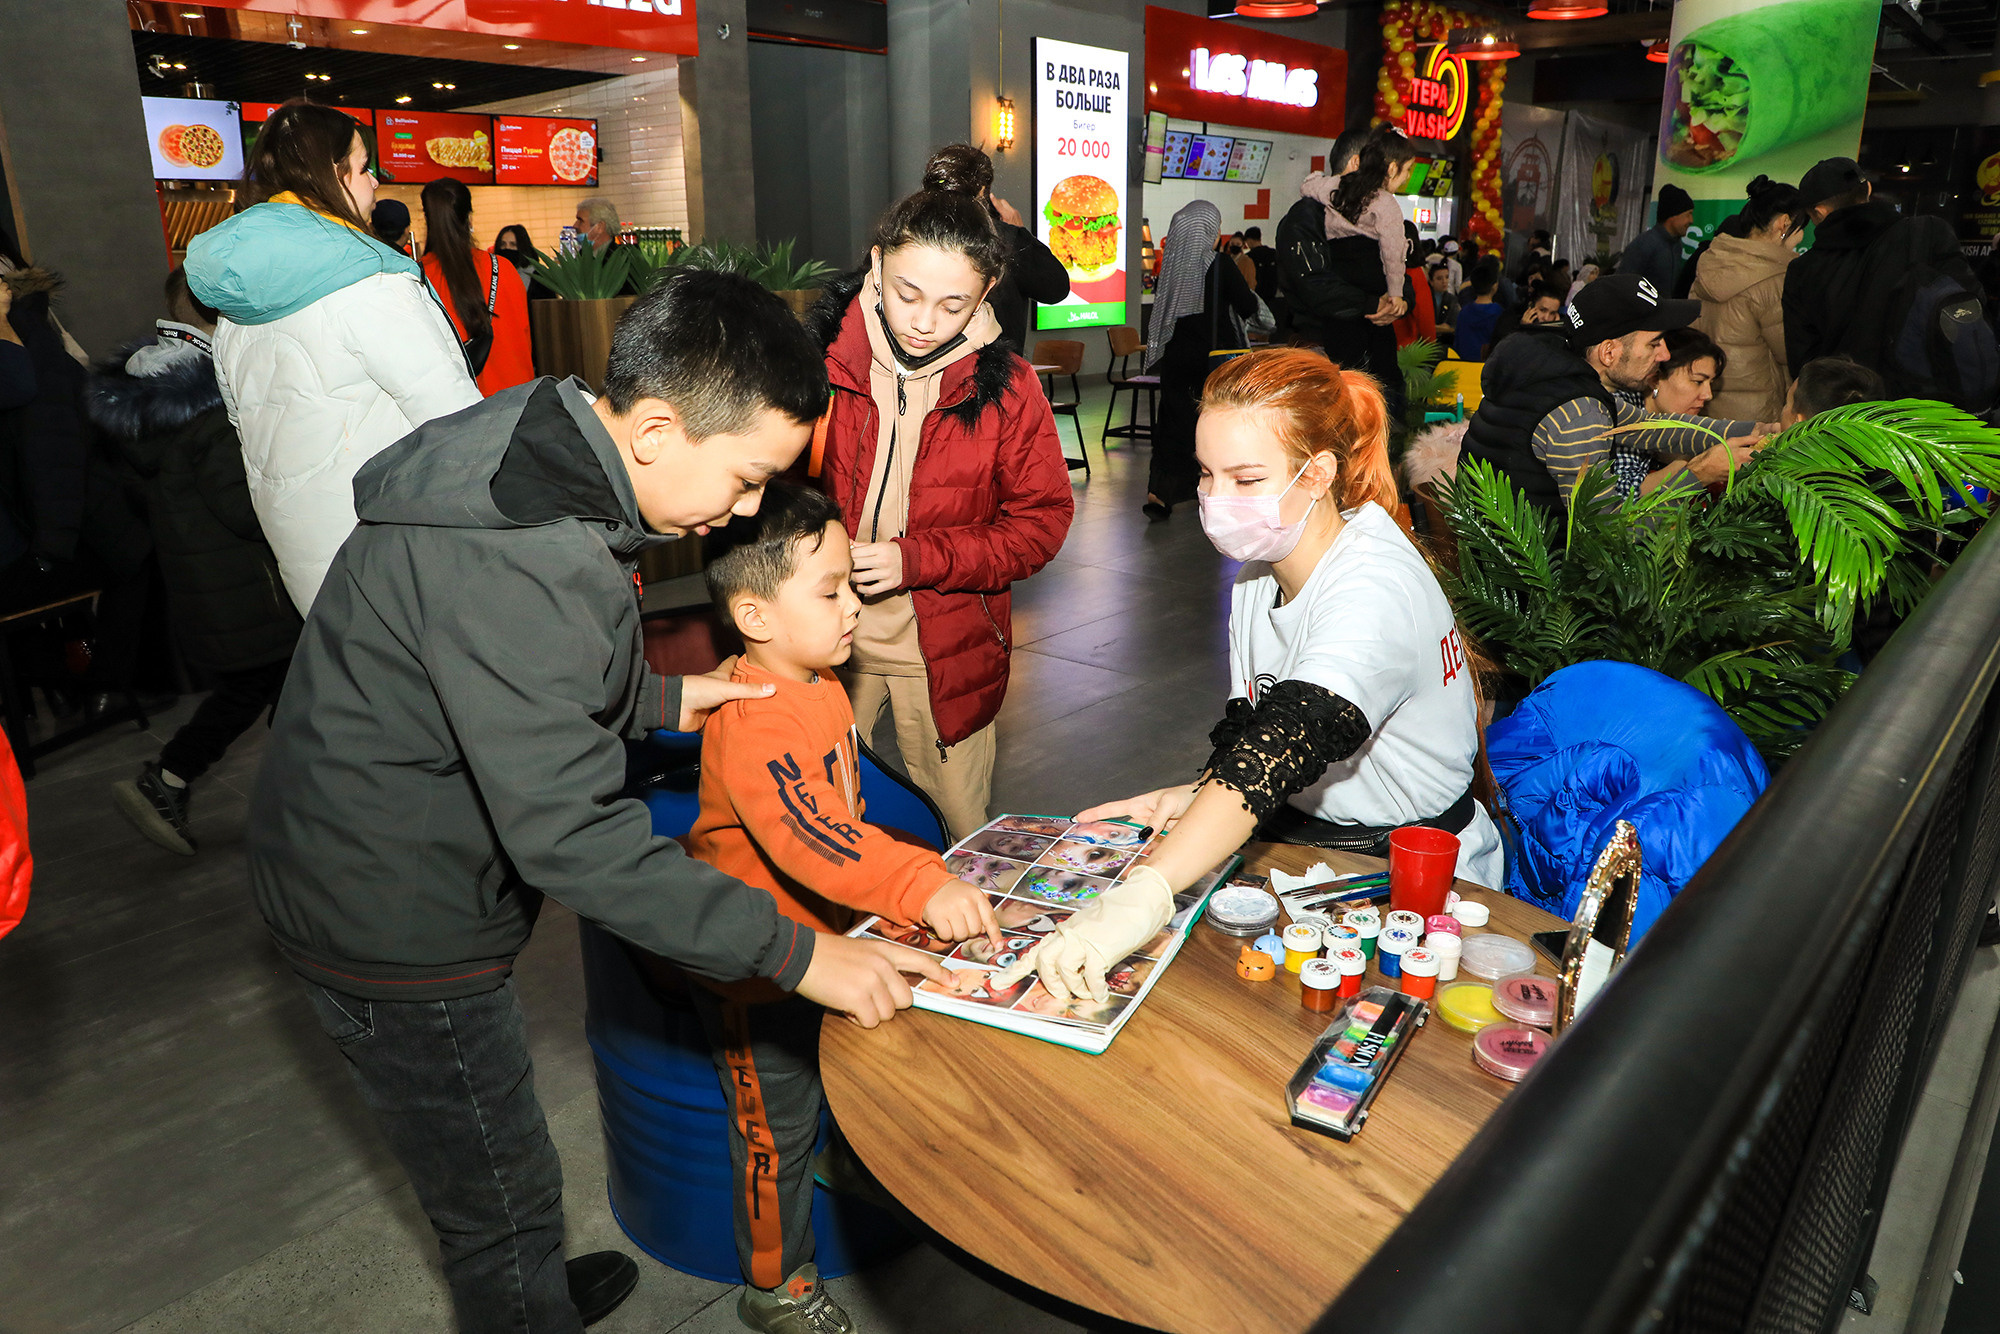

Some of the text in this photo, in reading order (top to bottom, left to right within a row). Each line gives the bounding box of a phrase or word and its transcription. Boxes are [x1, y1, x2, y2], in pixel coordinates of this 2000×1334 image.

[1046, 62, 1121, 90] В ДВА РАЗА
[1056, 89, 1112, 114] БОЛЬШЕ
[1411, 77, 1449, 110] TEPA
[1403, 109, 1448, 141] VASH
[1057, 137, 1110, 159] 20 000
